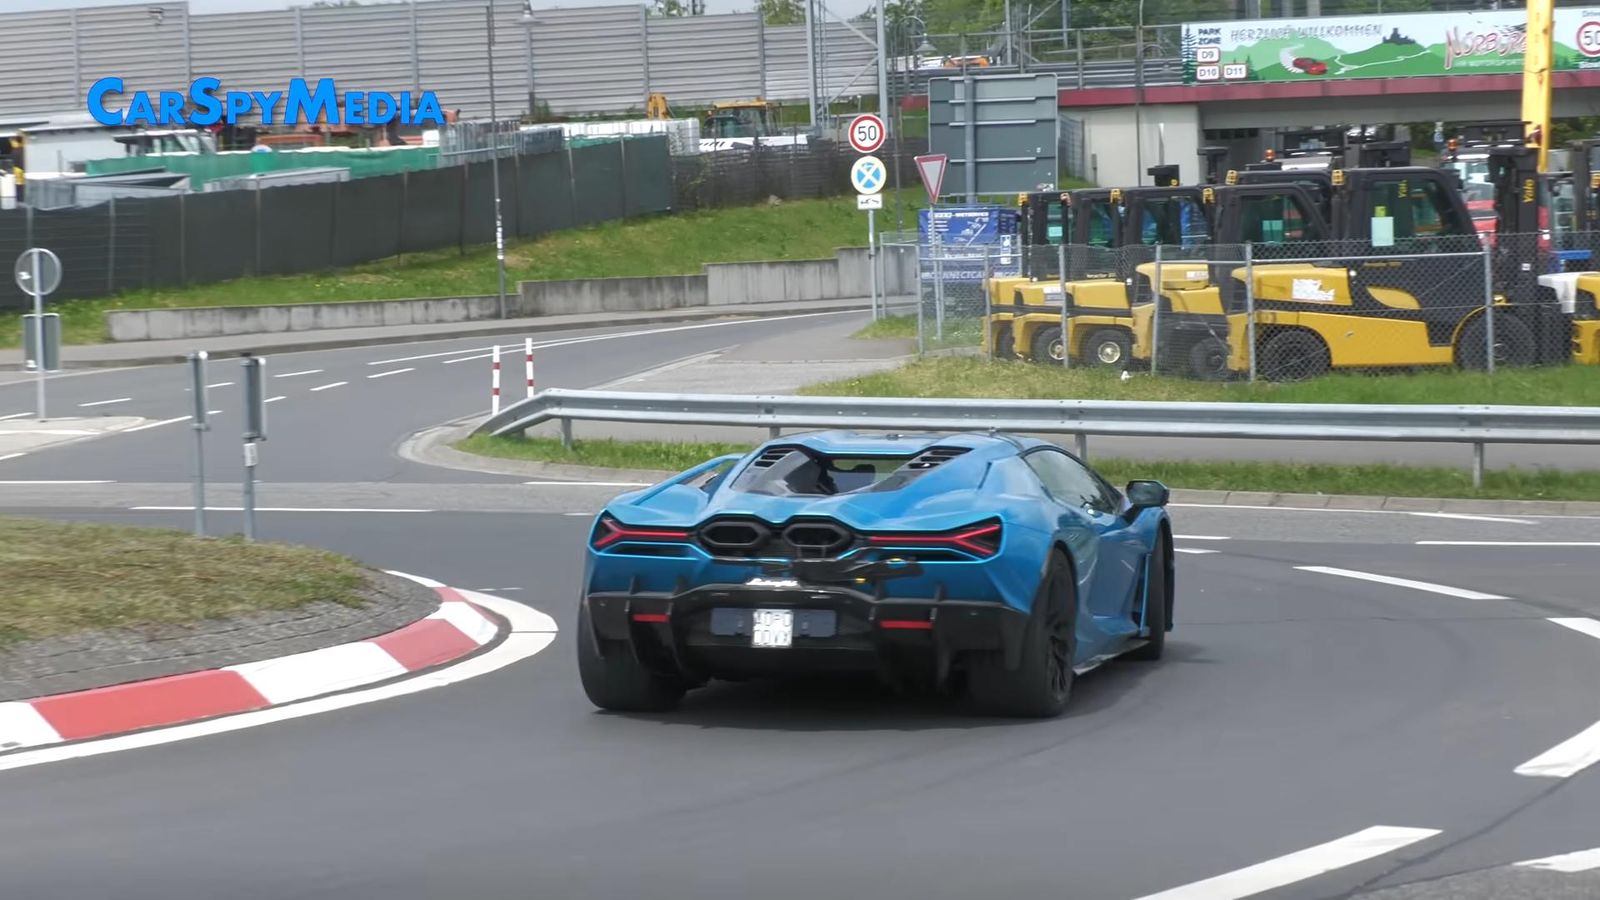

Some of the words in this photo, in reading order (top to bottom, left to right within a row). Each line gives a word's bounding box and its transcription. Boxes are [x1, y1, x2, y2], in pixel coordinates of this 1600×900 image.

[1198, 28, 1221, 36] PARK
[1198, 36, 1221, 45] ZONE
[1201, 51, 1214, 59] D9
[1199, 67, 1217, 77] D10
[1226, 67, 1242, 76] D11
[858, 125, 877, 142] 50
